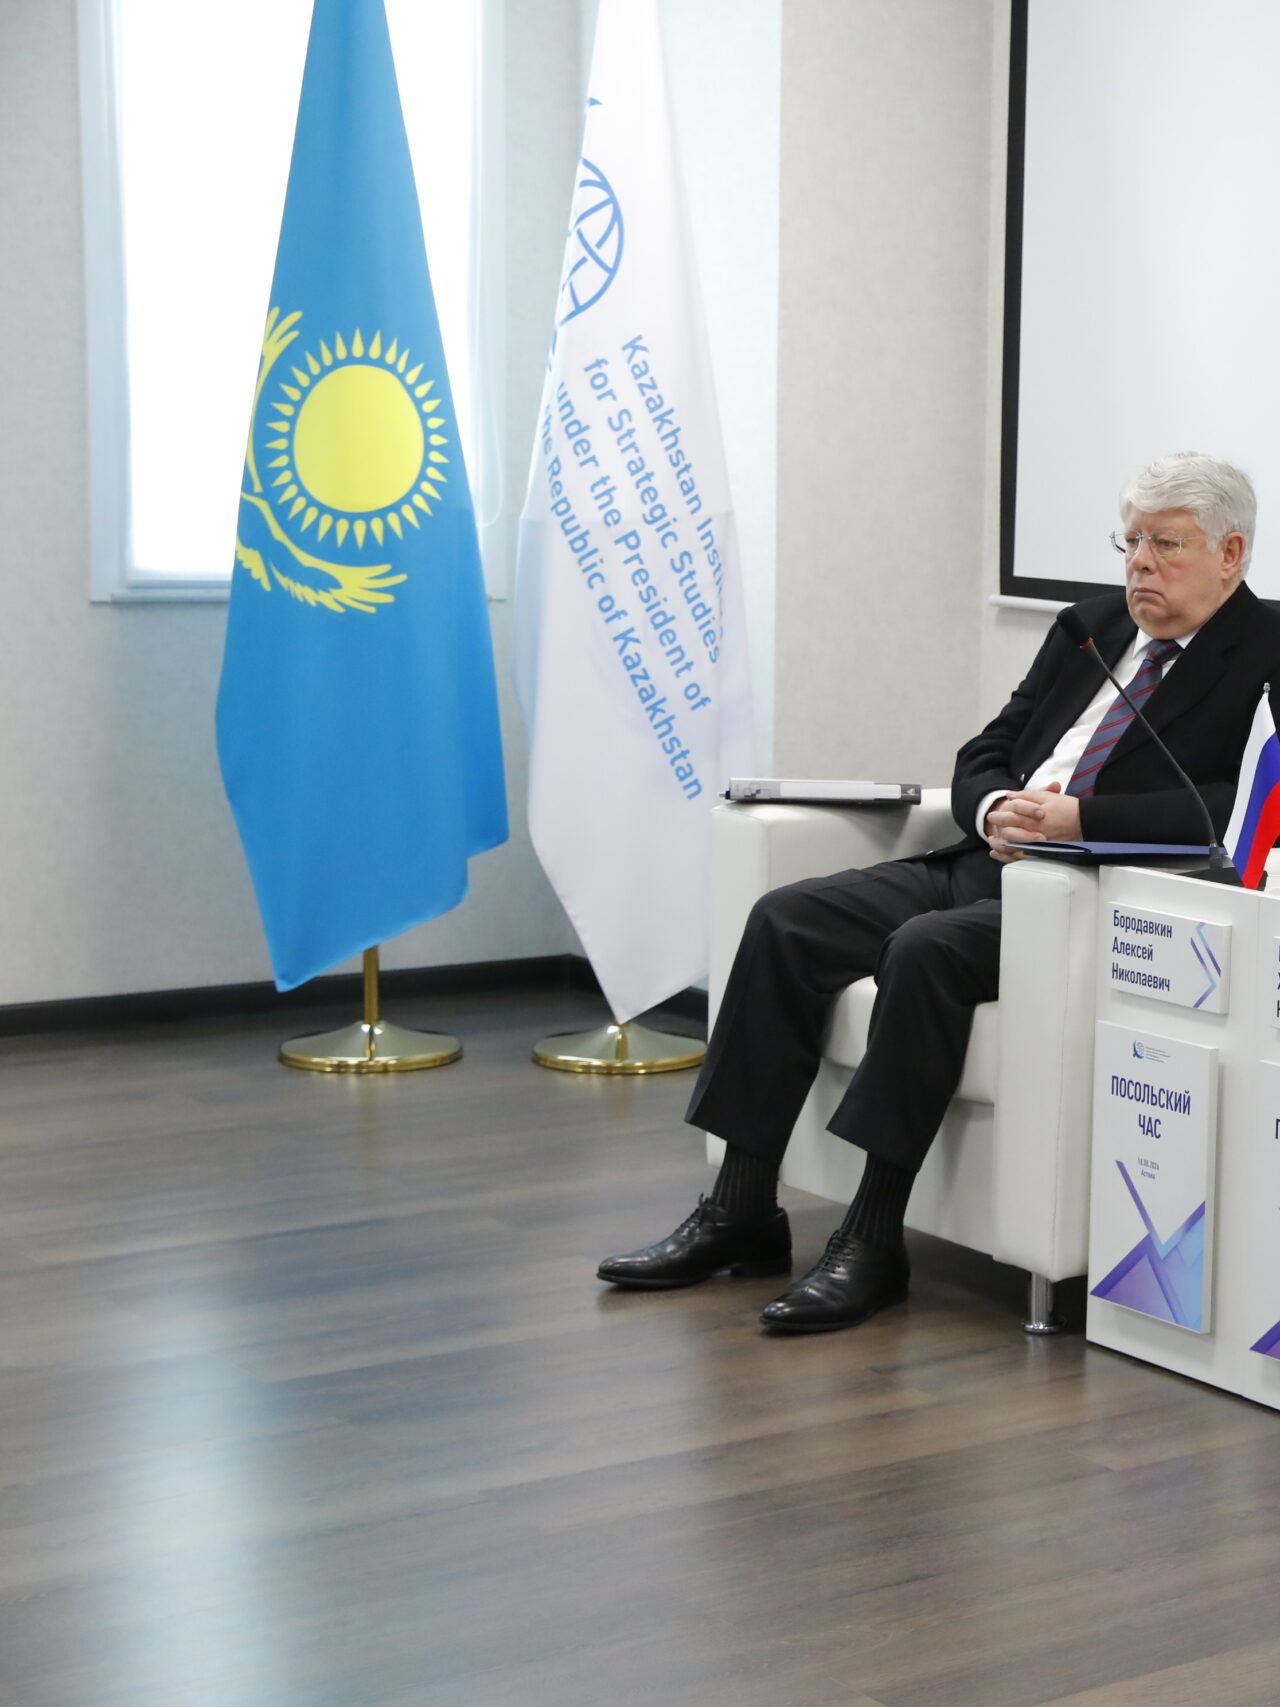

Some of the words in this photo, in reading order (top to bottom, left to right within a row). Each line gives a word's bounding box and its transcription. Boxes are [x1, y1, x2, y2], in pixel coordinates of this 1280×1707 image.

[620, 334, 703, 516] Kazakhstan
[547, 456, 607, 590] Republic
[583, 357, 618, 401] for
[607, 407, 679, 550] Strategic
[669, 550, 720, 664] Studies
[590, 474, 622, 529] the
[613, 529, 697, 678] President
[683, 682, 712, 712] of
[597, 594, 628, 624] of
[612, 627, 703, 801] Kazakhstan
[1113, 910, 1173, 939] Бородавкин
[1112, 936, 1153, 962] Алексей
[1111, 962, 1171, 992] Николаевич
[1111, 1075, 1191, 1116] ПОСОЛЬСКИЙ
[1138, 1113, 1161, 1139] ЧАС
